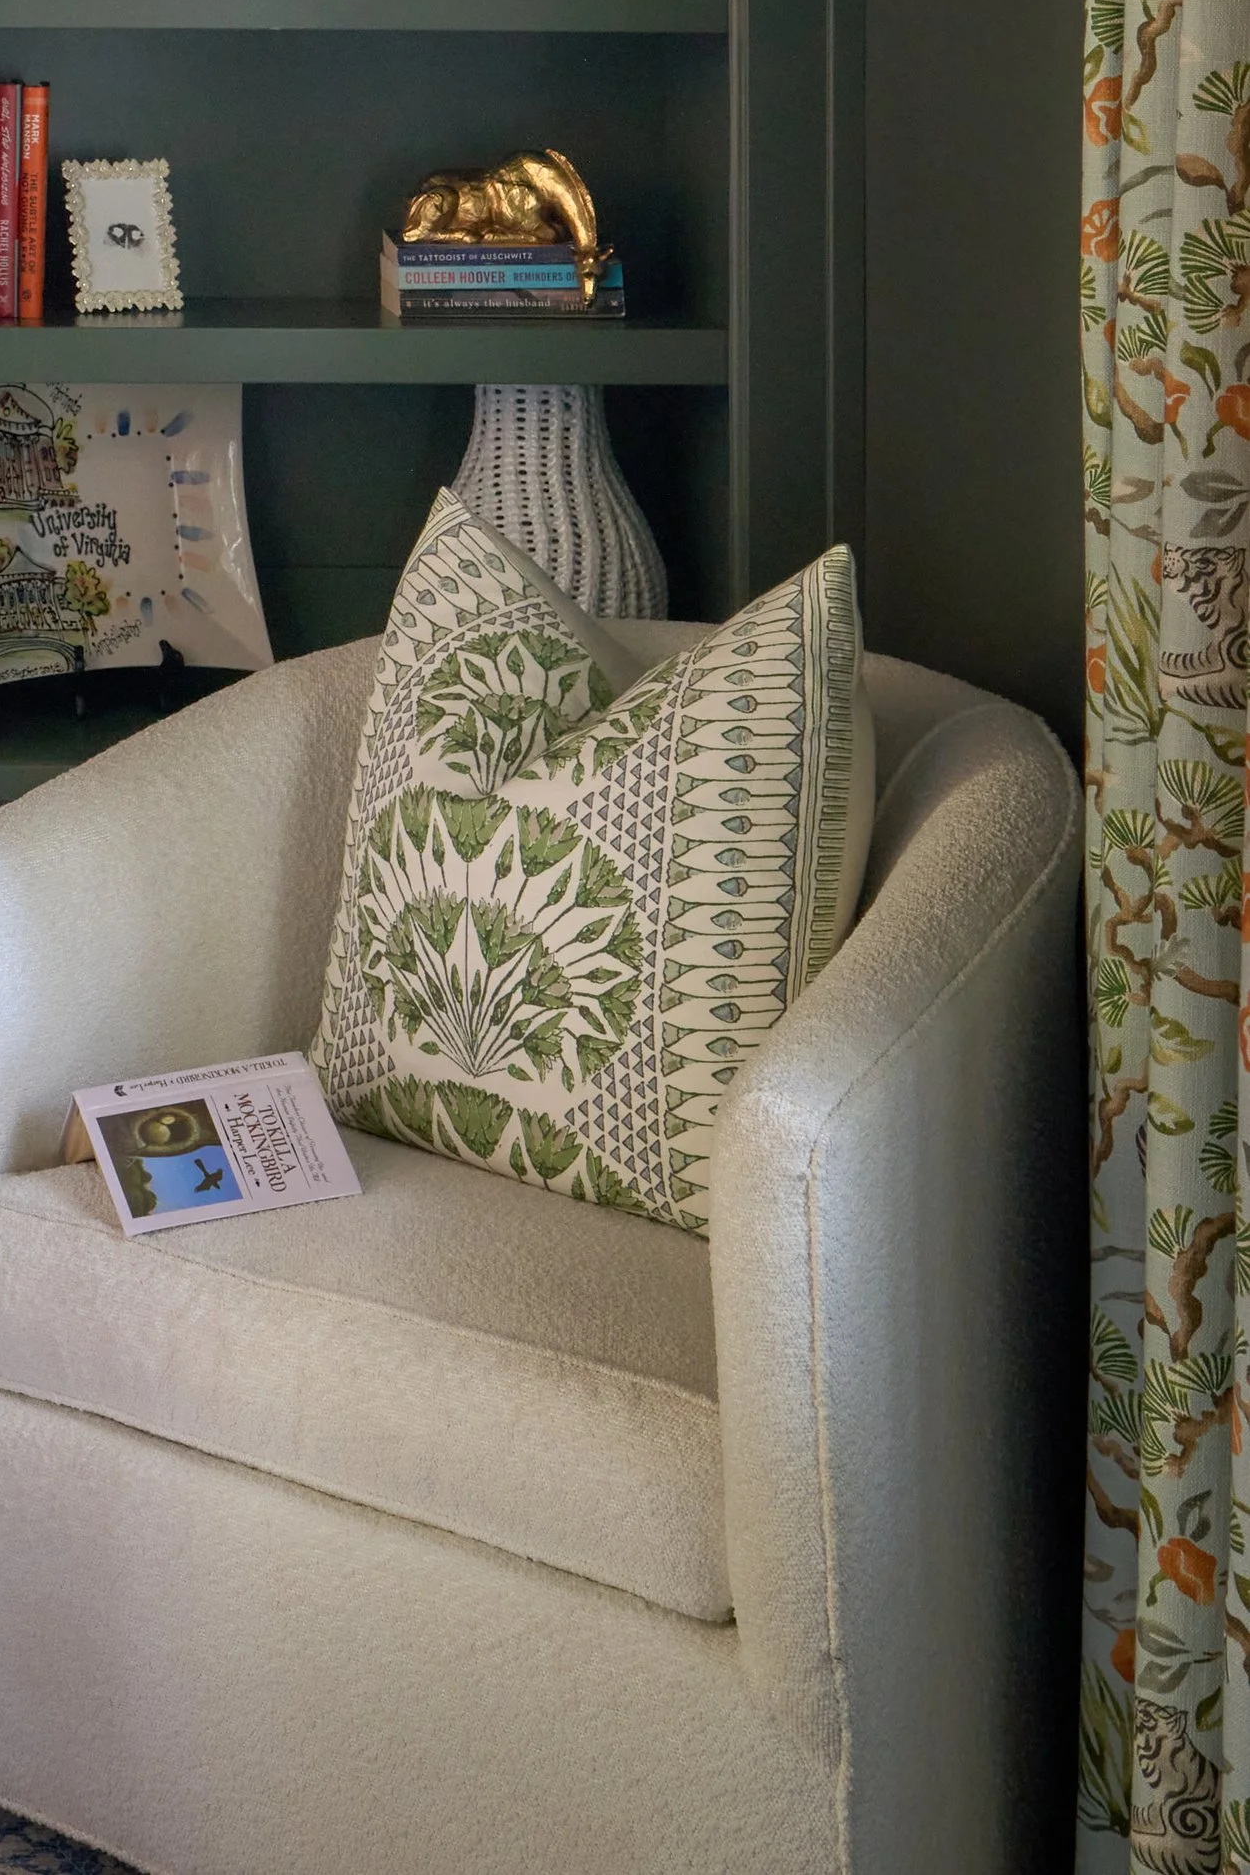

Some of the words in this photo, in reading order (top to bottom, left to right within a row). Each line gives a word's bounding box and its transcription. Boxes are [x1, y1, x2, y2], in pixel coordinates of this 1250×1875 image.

[0, 97, 10, 121] GIRL,
[1, 126, 11, 150] STOP
[23, 114, 31, 160] MANSON
[31, 114, 40, 144] MARK
[1, 151, 11, 206] APOLOGIZING
[21, 173, 29, 194] NOT
[30, 173, 38, 194] THE
[21, 197, 29, 233] GIVING
[29, 195, 38, 235] SUBTLE
[0, 219, 10, 253] RACHEL
[21, 235, 28, 243] A
[28, 237, 37, 260] ART
[418, 253, 466, 262] TATTOOIST
[480, 252, 532, 261] AUSCHWITZ
[0, 256, 10, 287] HOLLIS
[28, 261, 36, 275] OF
[405, 272, 456, 284] COLLEEN
[459, 271, 506, 284] HOOVER
[512, 272, 564, 282] REMINDERS
[423, 298, 439, 308] it's
[444, 298, 481, 310] always
[483, 298, 502, 308] the
[505, 298, 551, 308] husband
[29, 503, 118, 544] University
[53, 535, 69, 557] of
[70, 532, 131, 568] Virginia
[253, 1061, 272, 1071] KILL
[271, 1057, 288, 1068] TO
[176, 1067, 242, 1084] MOCKINGBIRD
[258, 1104, 278, 1126] TO
[227, 1116, 248, 1154] Harper
[241, 1153, 257, 1175] Lee
[233, 1092, 287, 1193] MOCKINGBIRD
[267, 1126, 291, 1161] KILL
[283, 1163, 297, 1174] A
